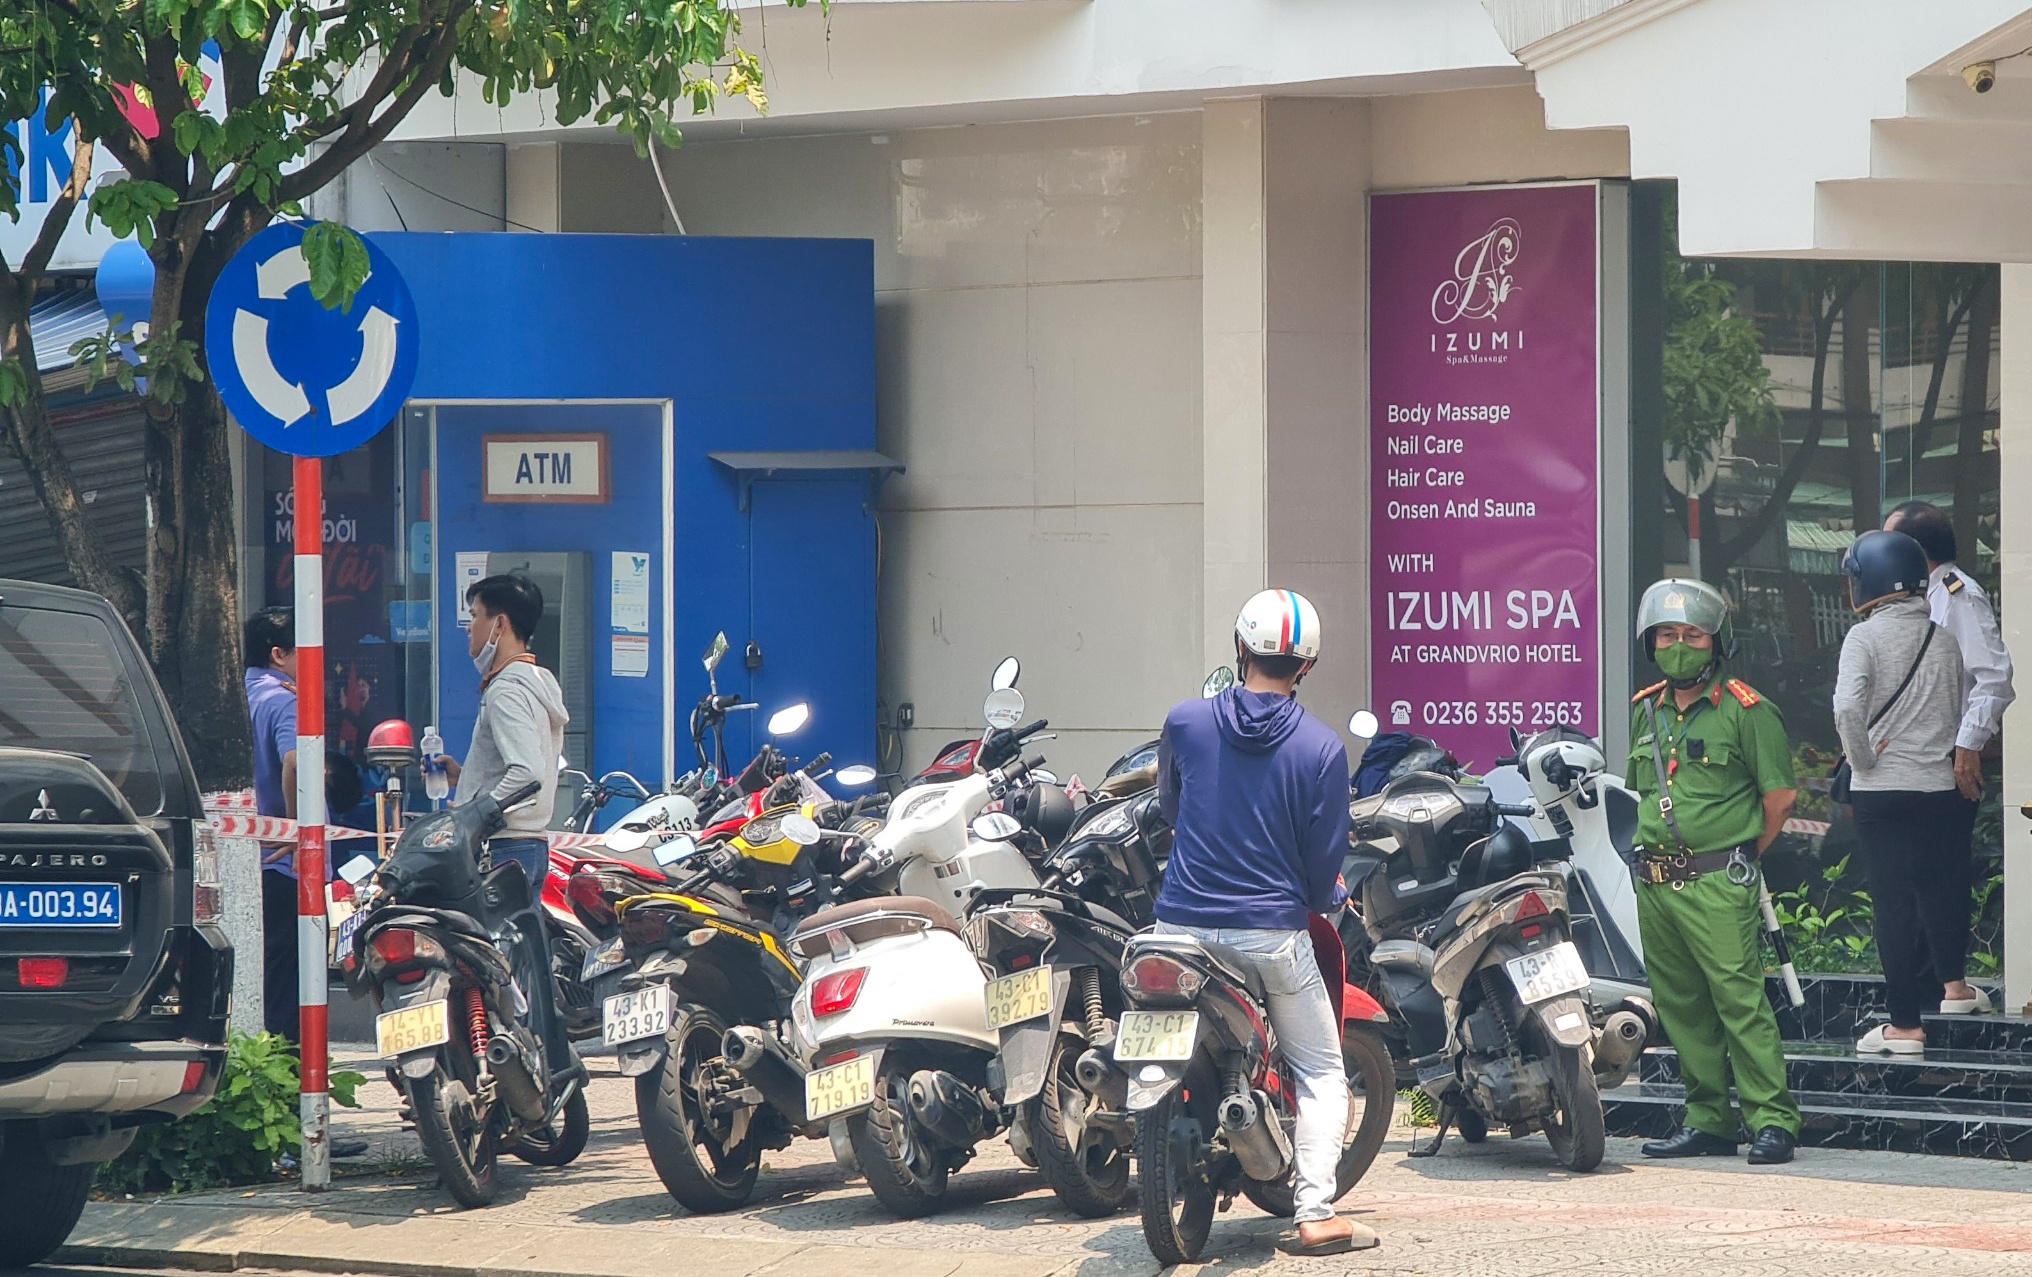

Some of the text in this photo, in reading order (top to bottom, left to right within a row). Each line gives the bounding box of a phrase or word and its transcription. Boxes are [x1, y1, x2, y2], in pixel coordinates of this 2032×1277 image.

[1431, 330, 1524, 352] IZUMI
[1388, 403, 1511, 426] Body Massage
[1387, 435, 1464, 455] Nail Care
[515, 452, 572, 485] ATM
[1387, 467, 1465, 487] Hair Care
[1387, 498, 1536, 519] Onsen And Sauna
[1387, 553, 1434, 572] WITH
[1387, 589, 1581, 631] IZUMI SPA
[1390, 644, 1582, 664] AT GRANDVRIO HOTEL
[1423, 701, 1582, 725] 0236 355 2563
[0, 890, 114, 918] A-003.94
[995, 970, 1040, 1001] 43-C1
[1526, 969, 1578, 997] 8559
[613, 990, 657, 1017] 43-K1
[990, 991, 1048, 1025] 392.79
[607, 1011, 664, 1043] 233.92
[1131, 1013, 1184, 1034] 43-C1
[816, 1062, 861, 1091] 43-C1
[811, 1082, 870, 1116] 719.19
